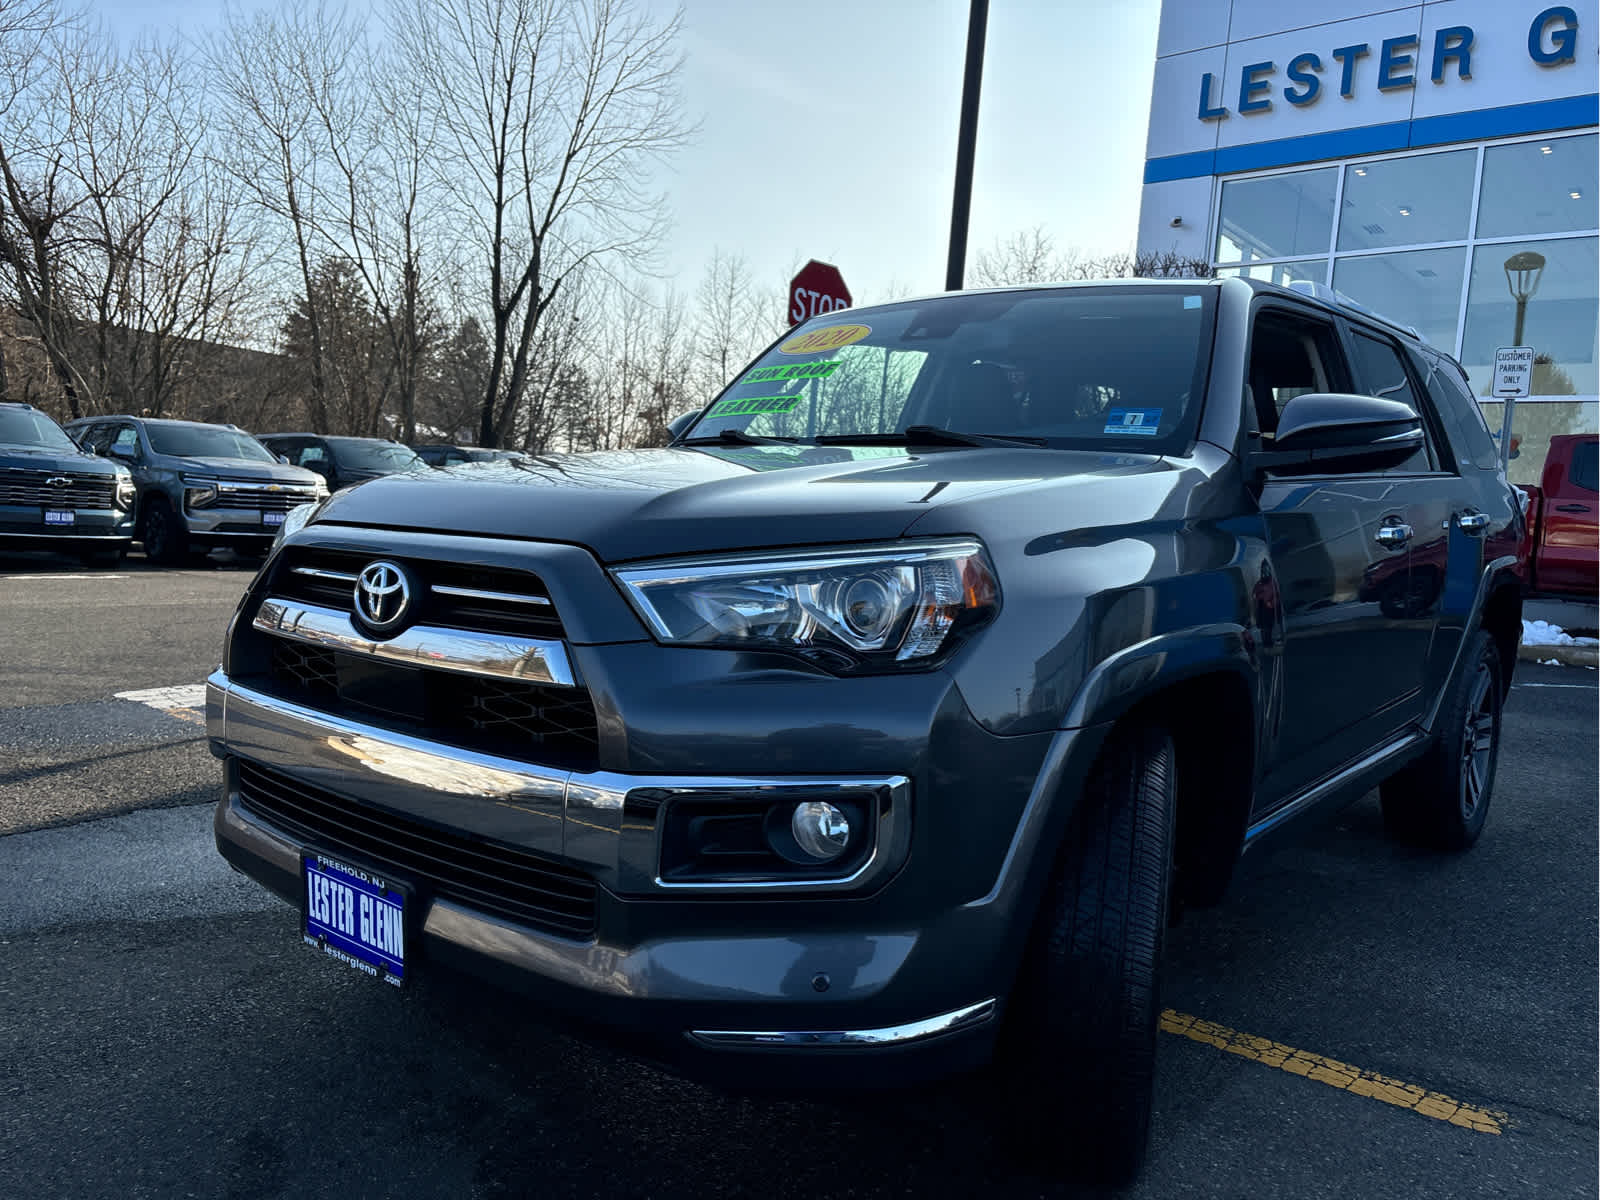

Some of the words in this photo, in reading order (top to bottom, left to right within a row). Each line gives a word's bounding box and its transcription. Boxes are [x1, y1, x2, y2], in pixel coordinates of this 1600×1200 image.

[1198, 26, 1476, 121] LESTER
[1527, 6, 1598, 67] G
[787, 327, 859, 351] 2020
[1498, 352, 1531, 361] CUSTOMER
[748, 368, 784, 380] SUN
[784, 363, 839, 377] ROOF
[1499, 364, 1527, 372] PARKING
[1503, 376, 1520, 384] ONLY
[711, 398, 798, 415] LEATHER
[317, 855, 370, 884] FREEHOLD,
[372, 877, 385, 889] NJ
[308, 871, 355, 936] LESTER
[359, 893, 404, 960] GLENN
